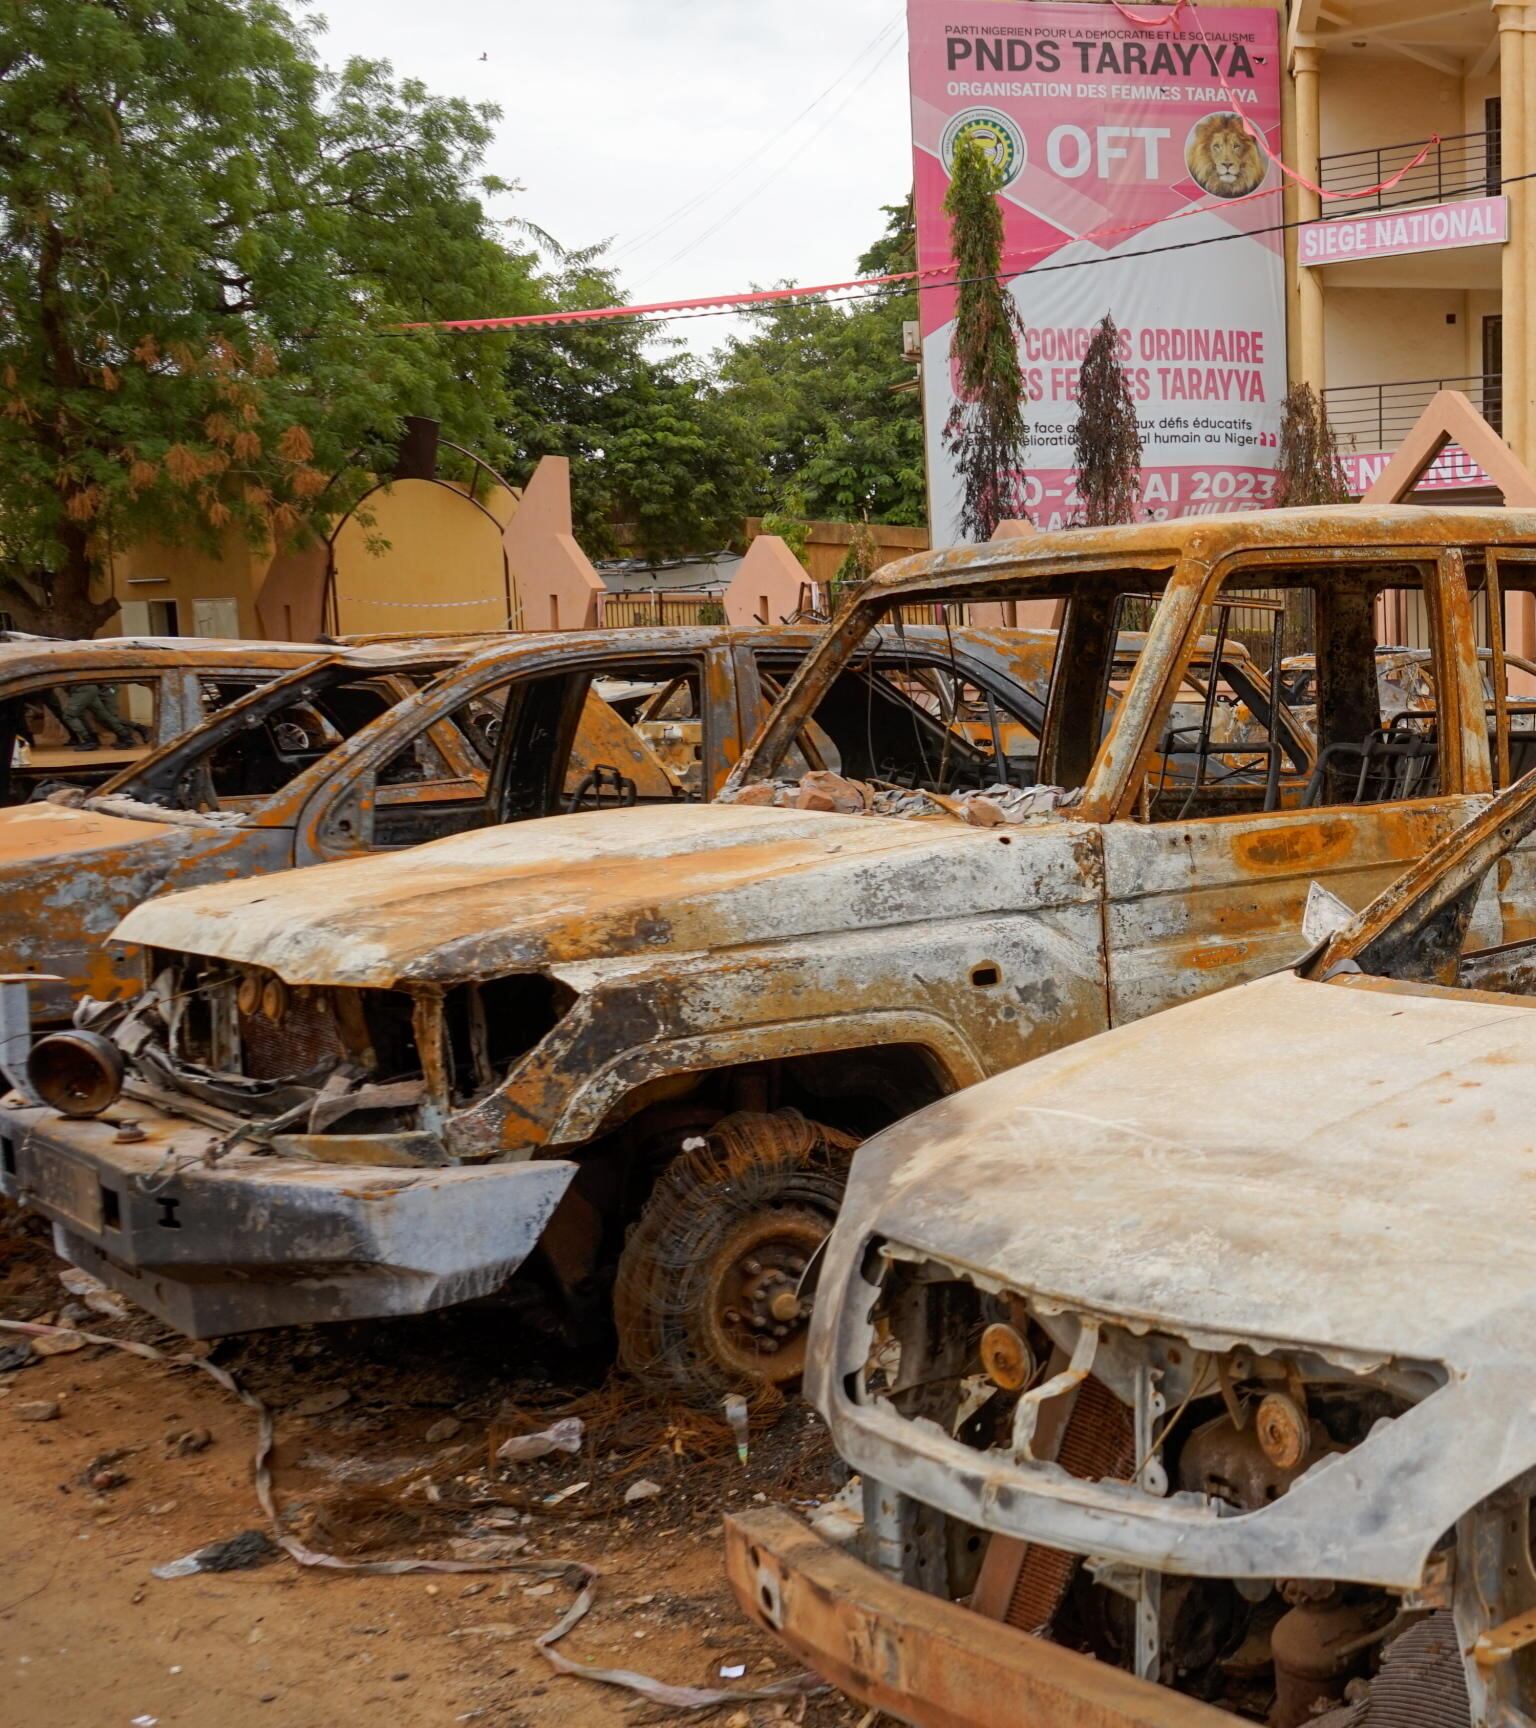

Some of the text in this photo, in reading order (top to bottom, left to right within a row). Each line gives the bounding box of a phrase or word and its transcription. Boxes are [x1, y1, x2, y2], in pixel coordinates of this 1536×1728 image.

[944, 25, 1256, 43] PARTI NIGERIEN POUR LA DEMOCRATIE ET LE SOCIALISME
[946, 37, 1255, 78] PNDS TARAYYA
[946, 81, 1258, 103] ORGANISATION DES FEMMES TARAYYA
[1046, 124, 1171, 180] OFT
[1304, 204, 1497, 259] SIEGE NATIONAL
[1026, 327, 1265, 364] CONGS ORDINAIRE
[1051, 367, 1151, 402] FEES
[1157, 367, 1266, 403] TARAYYA
[1034, 422, 1063, 434] face
[1158, 418, 1189, 430] défis
[1193, 417, 1253, 431] éducatifs
[1153, 432, 1199, 445] humain
[1204, 434, 1221, 444] au
[1189, 471, 1277, 500] 2023
